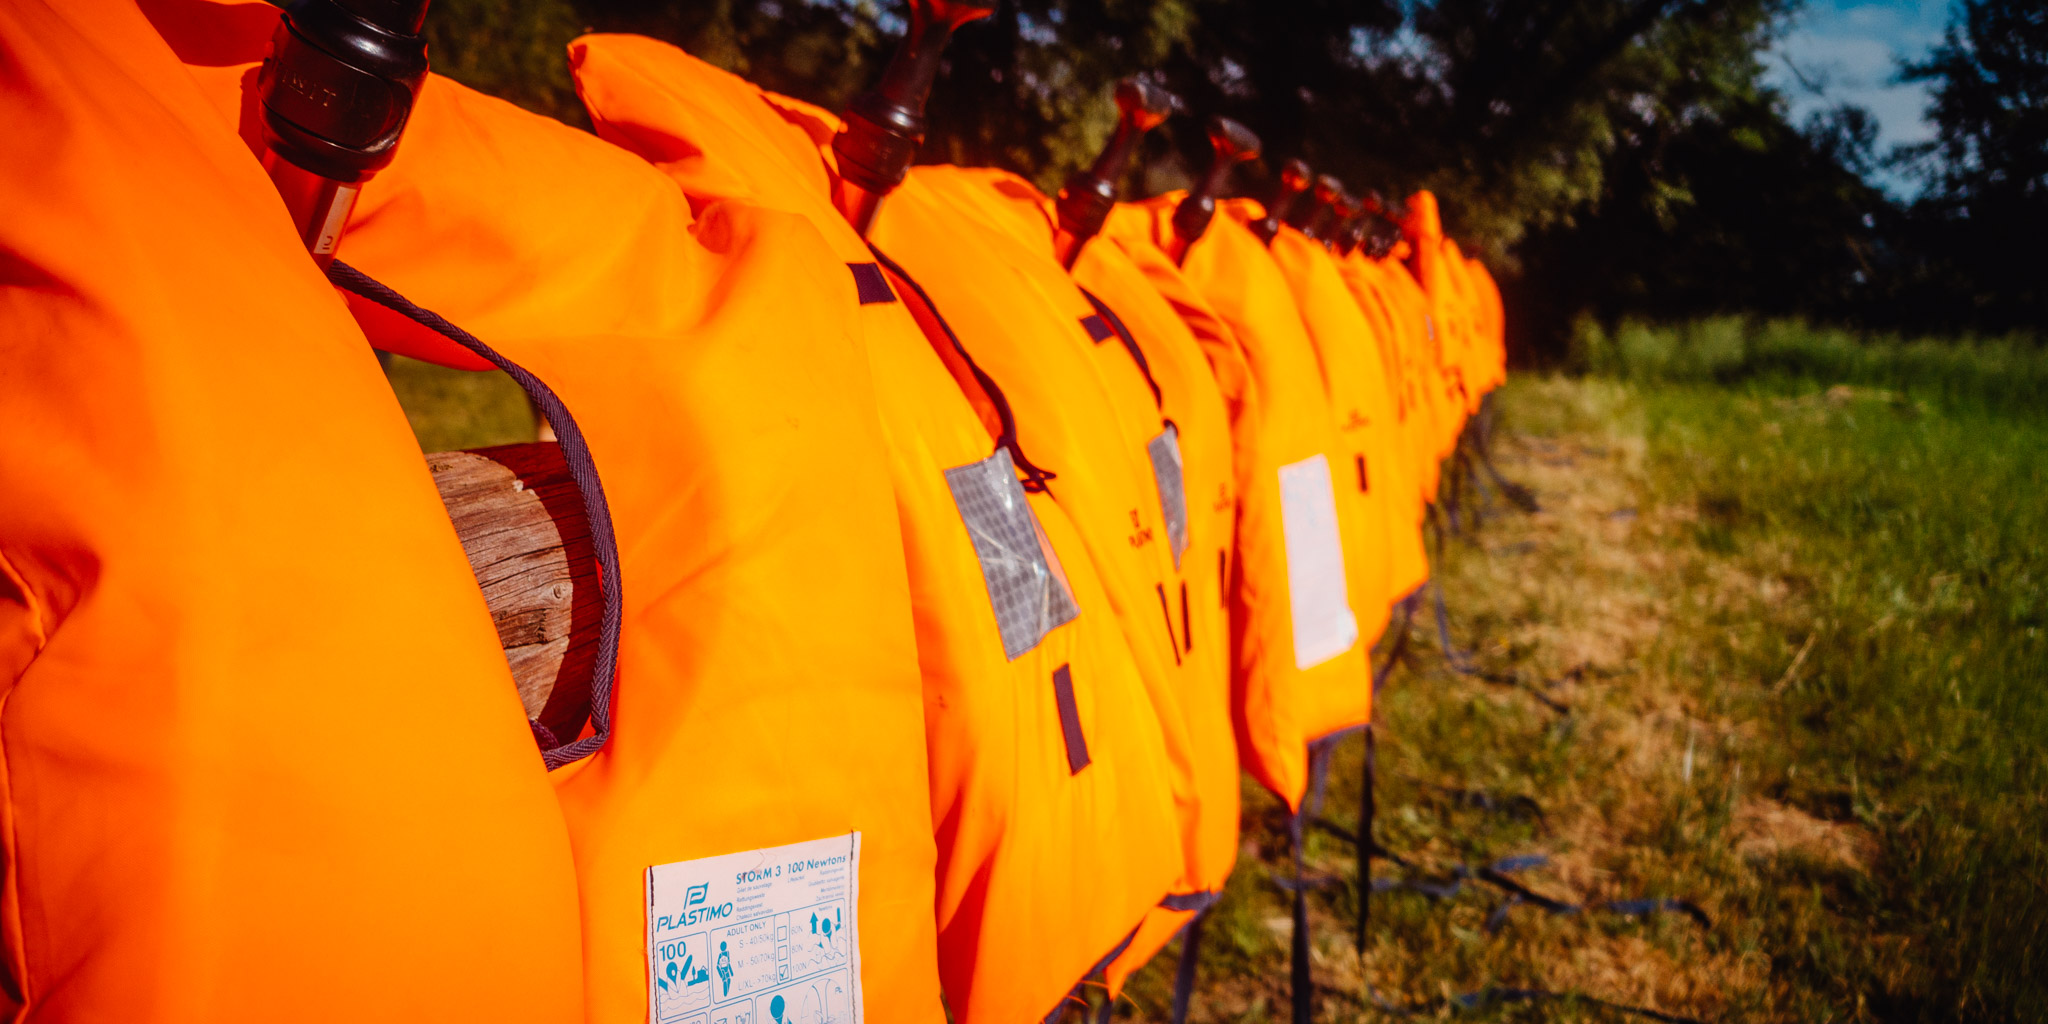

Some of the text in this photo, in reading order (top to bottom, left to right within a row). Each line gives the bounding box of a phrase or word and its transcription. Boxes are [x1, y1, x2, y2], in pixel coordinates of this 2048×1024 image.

[736, 867, 772, 885] STORM
[775, 865, 781, 877] 3
[788, 861, 804, 874] 100
[807, 856, 846, 870] Newtons
[656, 902, 733, 932] PLASTIMO
[727, 921, 767, 937] ADULT ONLY
[659, 941, 686, 960] 100
